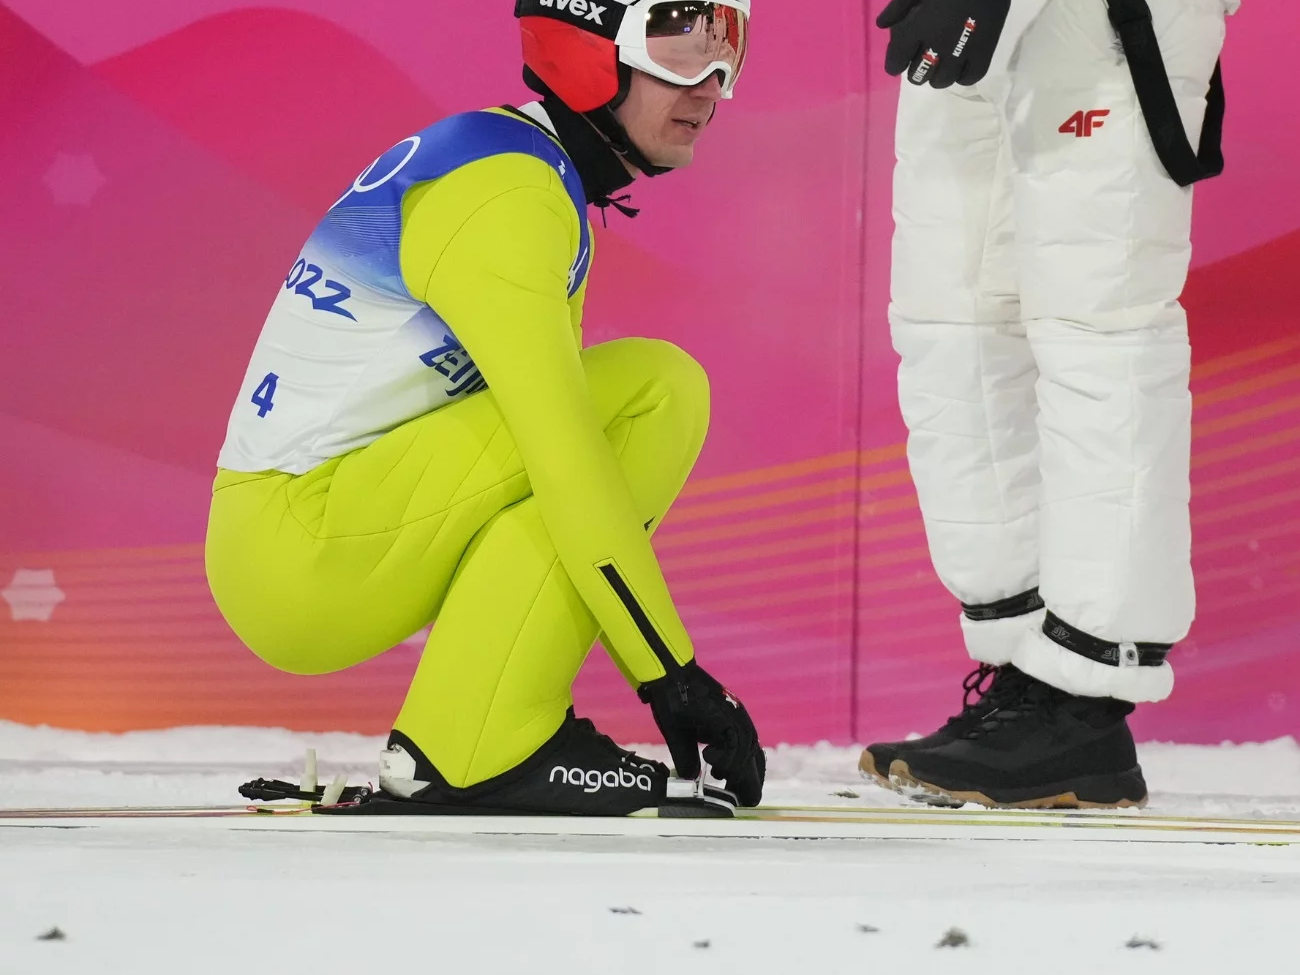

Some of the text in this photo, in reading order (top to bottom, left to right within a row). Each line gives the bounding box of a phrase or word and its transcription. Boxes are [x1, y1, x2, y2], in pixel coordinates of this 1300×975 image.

[1058, 109, 1110, 137] 4F
[284, 258, 358, 322] 022
[251, 372, 279, 418] 4
[549, 765, 651, 793] nagaba
